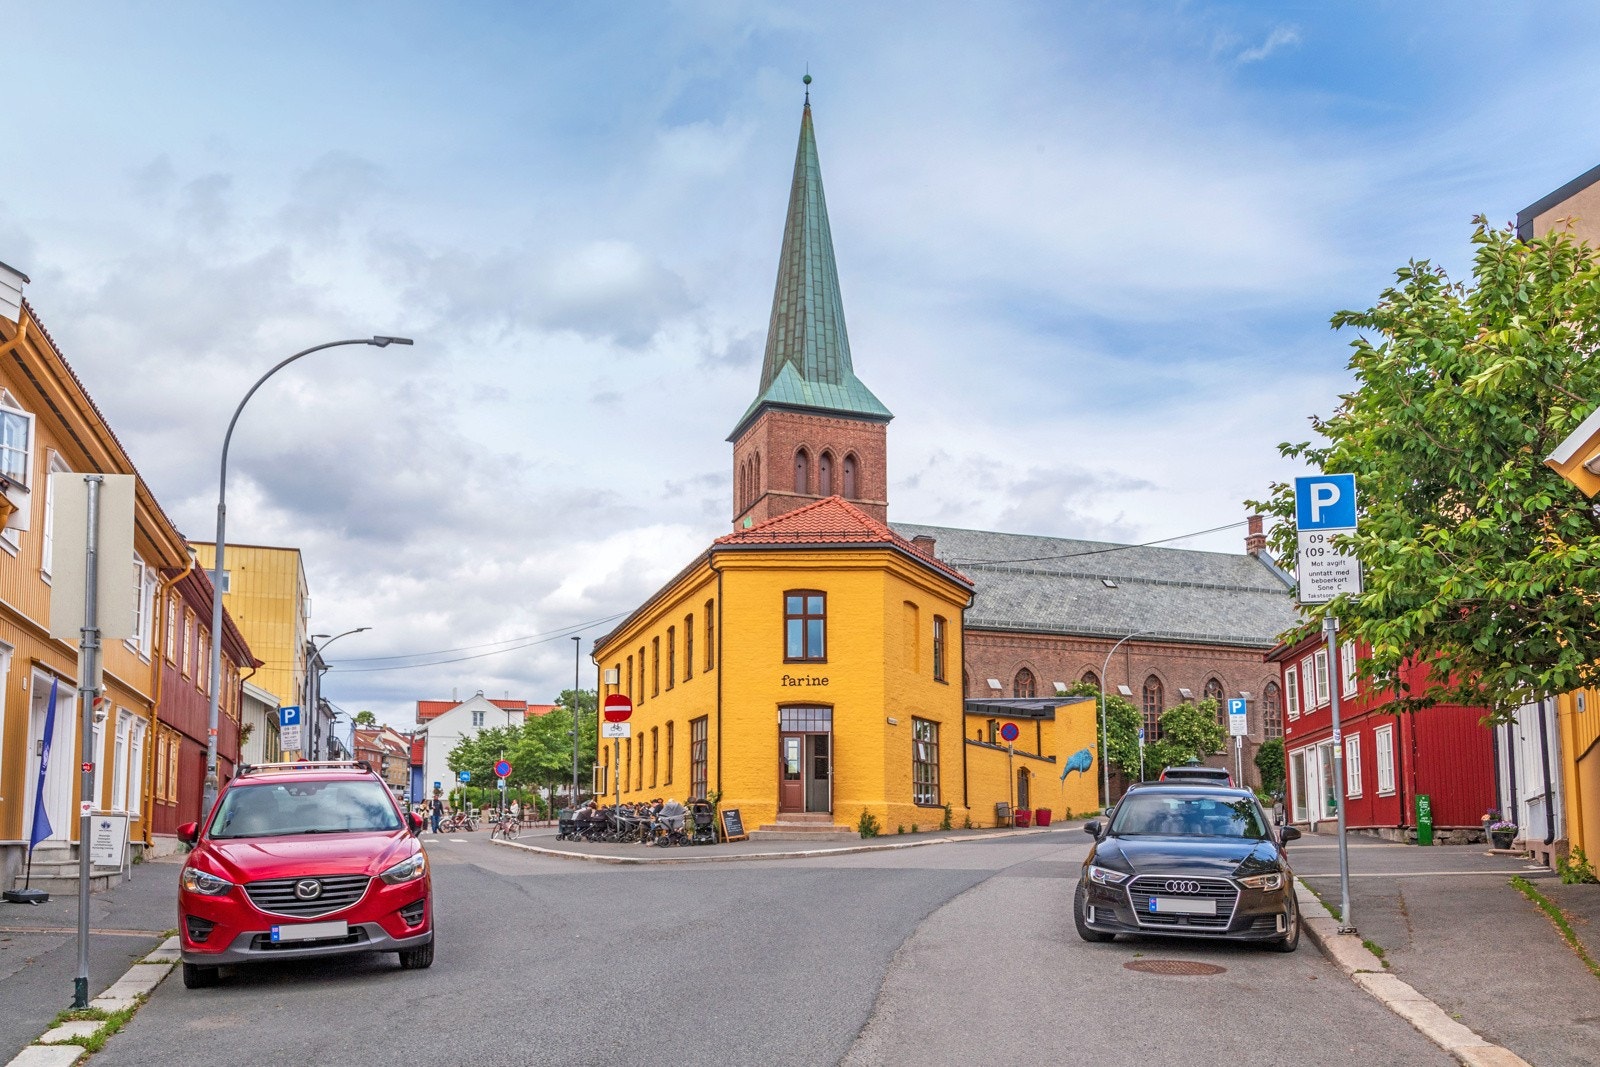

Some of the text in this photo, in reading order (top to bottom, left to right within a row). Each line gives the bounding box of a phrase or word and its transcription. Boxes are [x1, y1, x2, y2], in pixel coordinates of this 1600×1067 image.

[1310, 482, 1341, 523] P
[781, 674, 829, 687] farine
[1232, 700, 1242, 713] P
[284, 709, 295, 724] P
